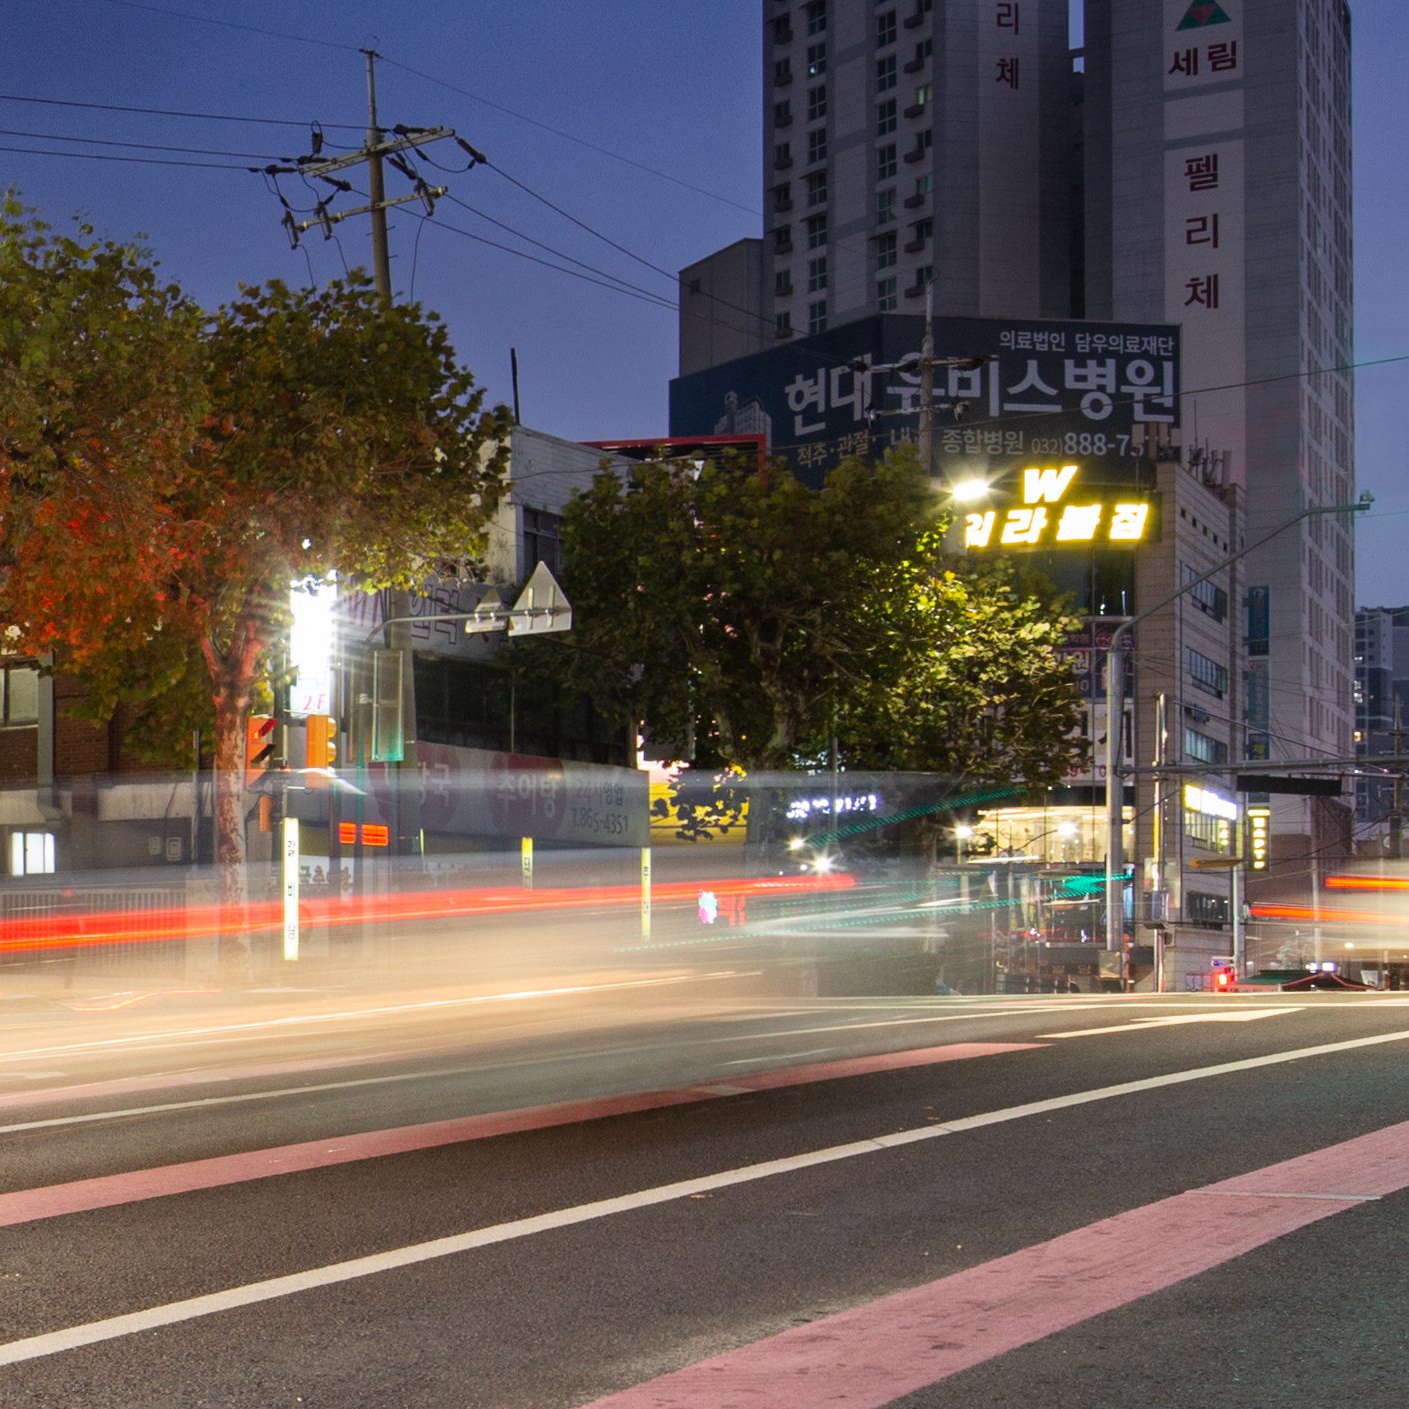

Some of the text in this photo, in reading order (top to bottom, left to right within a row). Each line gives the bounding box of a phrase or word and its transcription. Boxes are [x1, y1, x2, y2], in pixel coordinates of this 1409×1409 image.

[1167, 40, 1237, 77] 세림
[999, 330, 1175, 357] 의료법인 담우의료재단
[941, 429, 1024, 455] 종합병원
[1023, 465, 1079, 504] W
[496, 773, 560, 819] 추어탕
